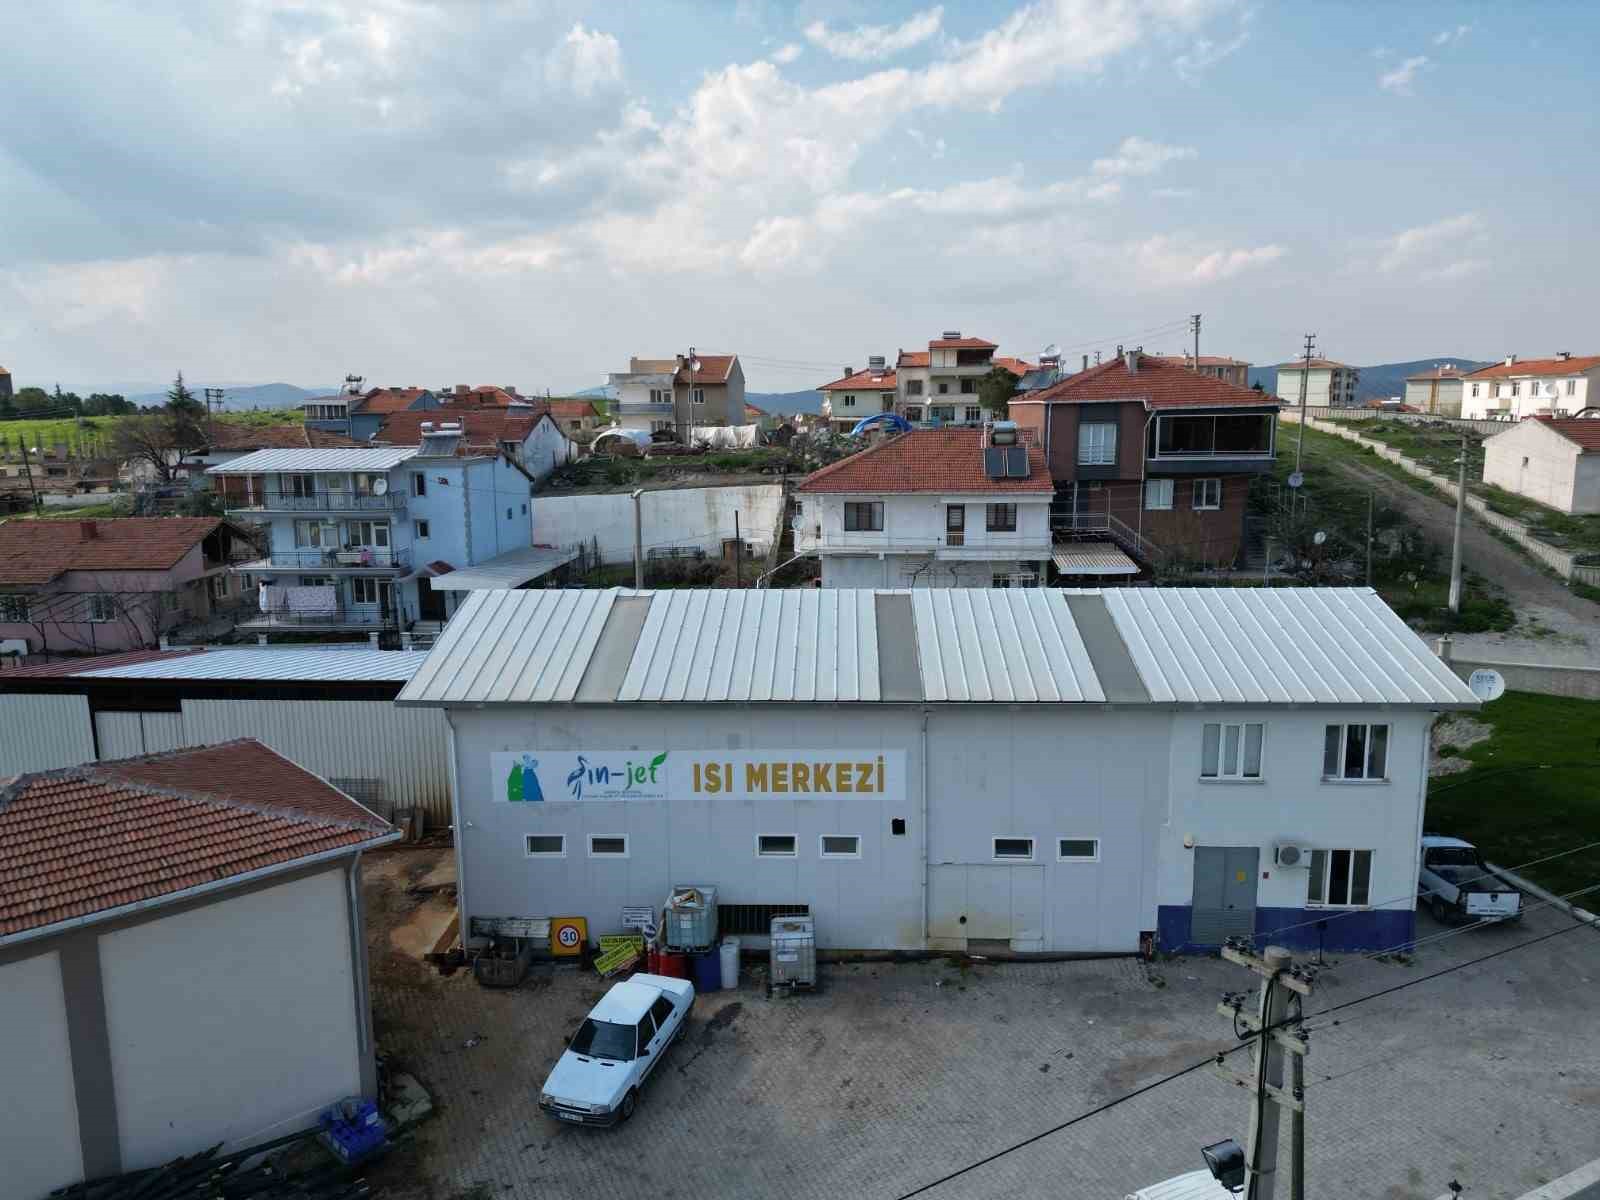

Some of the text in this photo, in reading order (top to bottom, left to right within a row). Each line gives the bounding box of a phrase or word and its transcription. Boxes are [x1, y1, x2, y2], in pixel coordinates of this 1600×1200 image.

[693, 756, 885, 793] ISI MERKEZİ
[562, 931, 577, 942] 30
